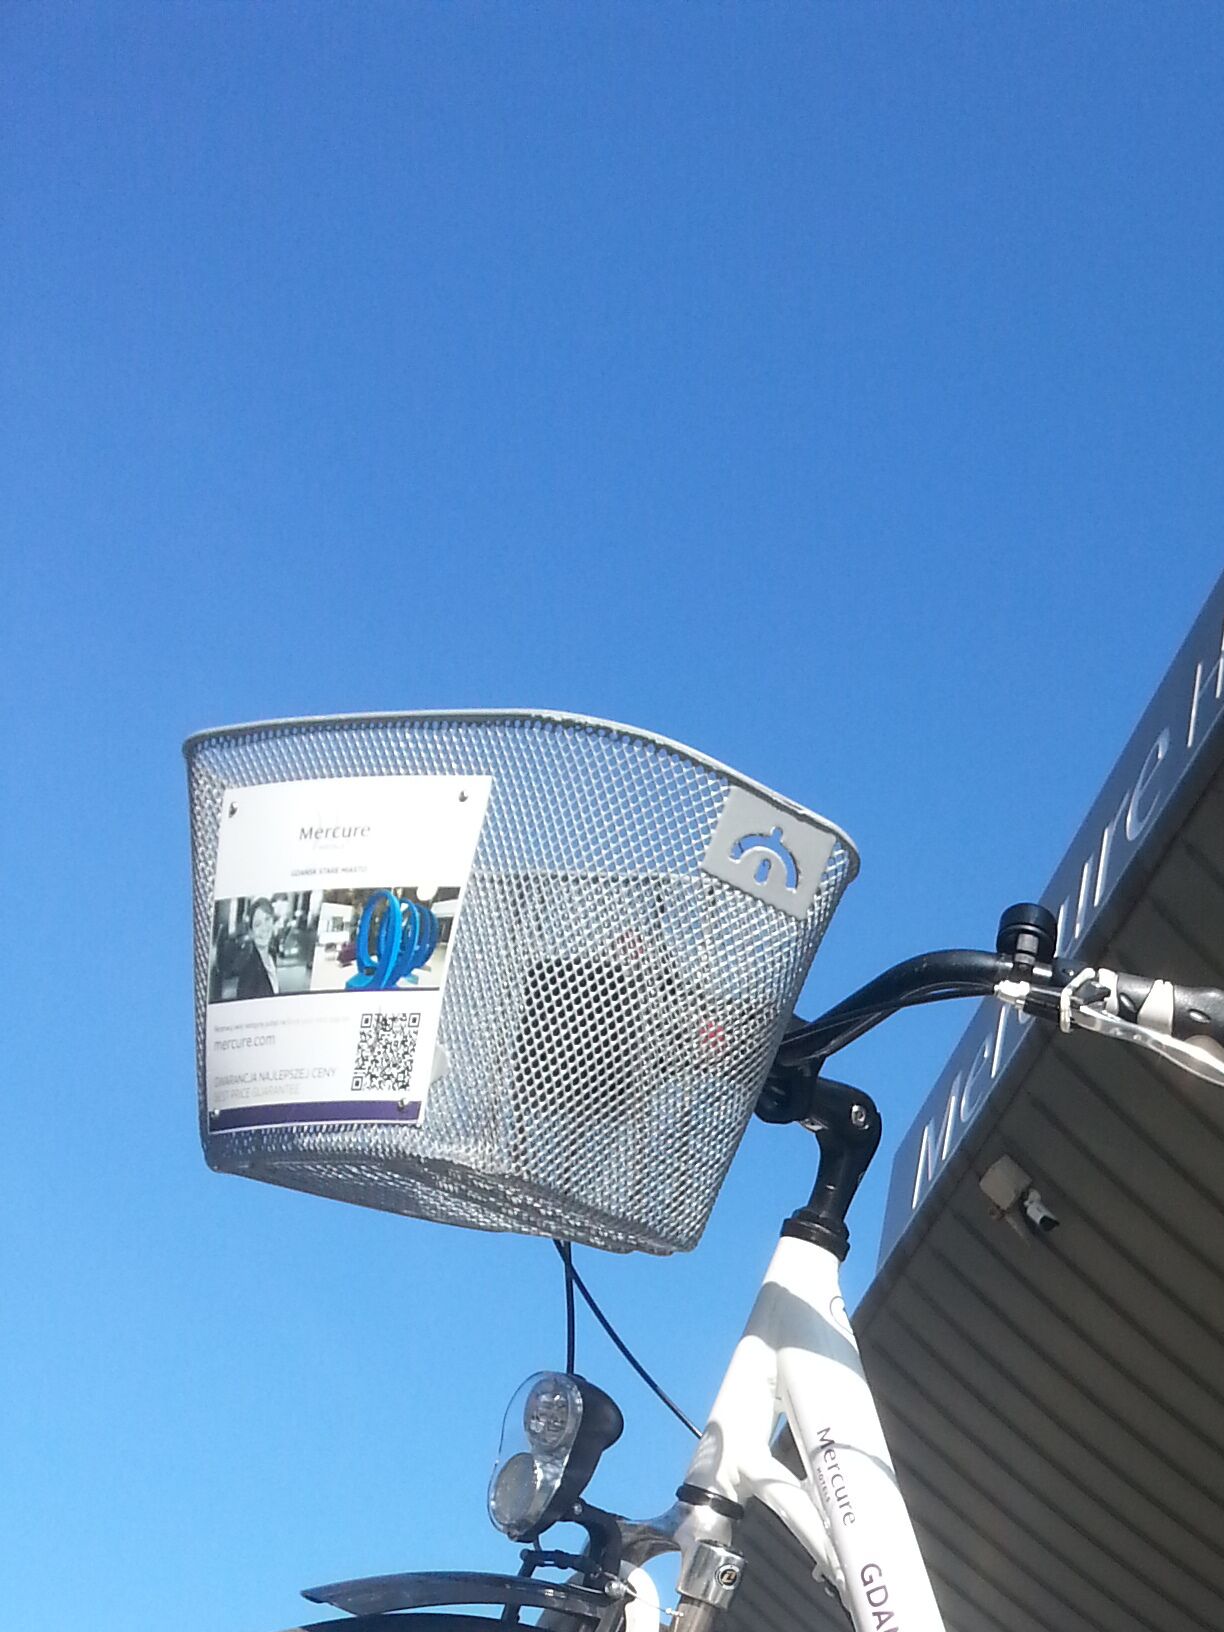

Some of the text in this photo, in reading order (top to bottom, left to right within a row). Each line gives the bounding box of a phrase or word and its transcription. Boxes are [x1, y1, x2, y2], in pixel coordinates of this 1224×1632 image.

[299, 824, 371, 840] Mercure
[911, 738, 1171, 1210] Merure
[213, 1034, 276, 1051] mercure.com
[815, 1426, 856, 1525] Mercure
[815, 1467, 832, 1503] HOTELS
